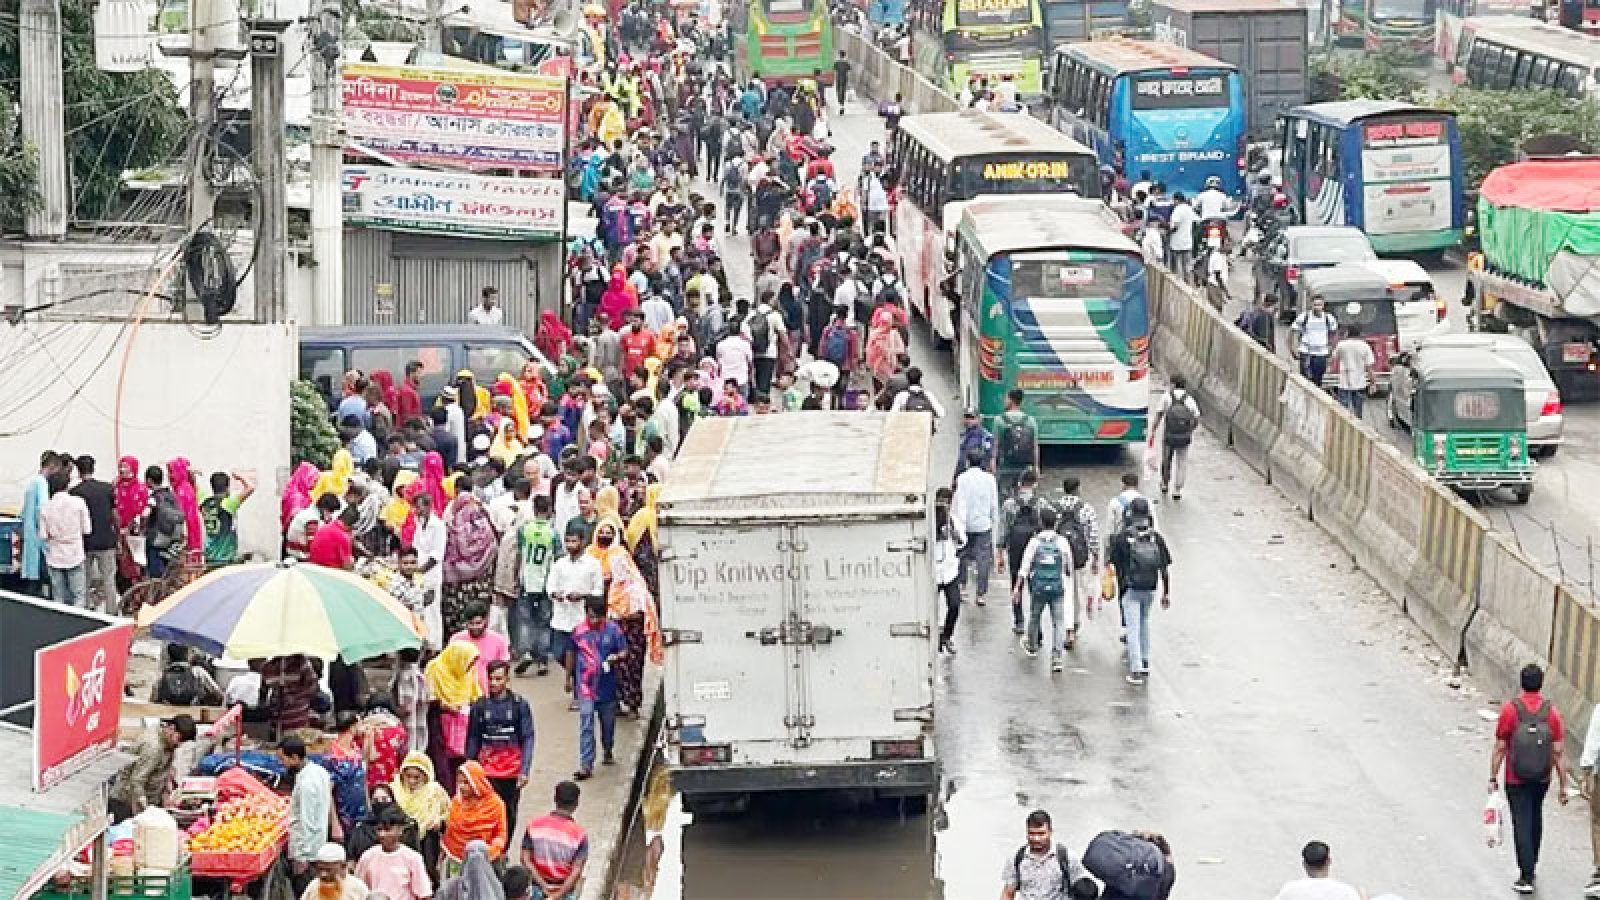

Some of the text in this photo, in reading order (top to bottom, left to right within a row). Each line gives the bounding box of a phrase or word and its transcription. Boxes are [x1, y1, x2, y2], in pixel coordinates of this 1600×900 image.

[479, 180, 561, 197] Travels
[673, 553, 913, 591] Dip Knitwear Limited
